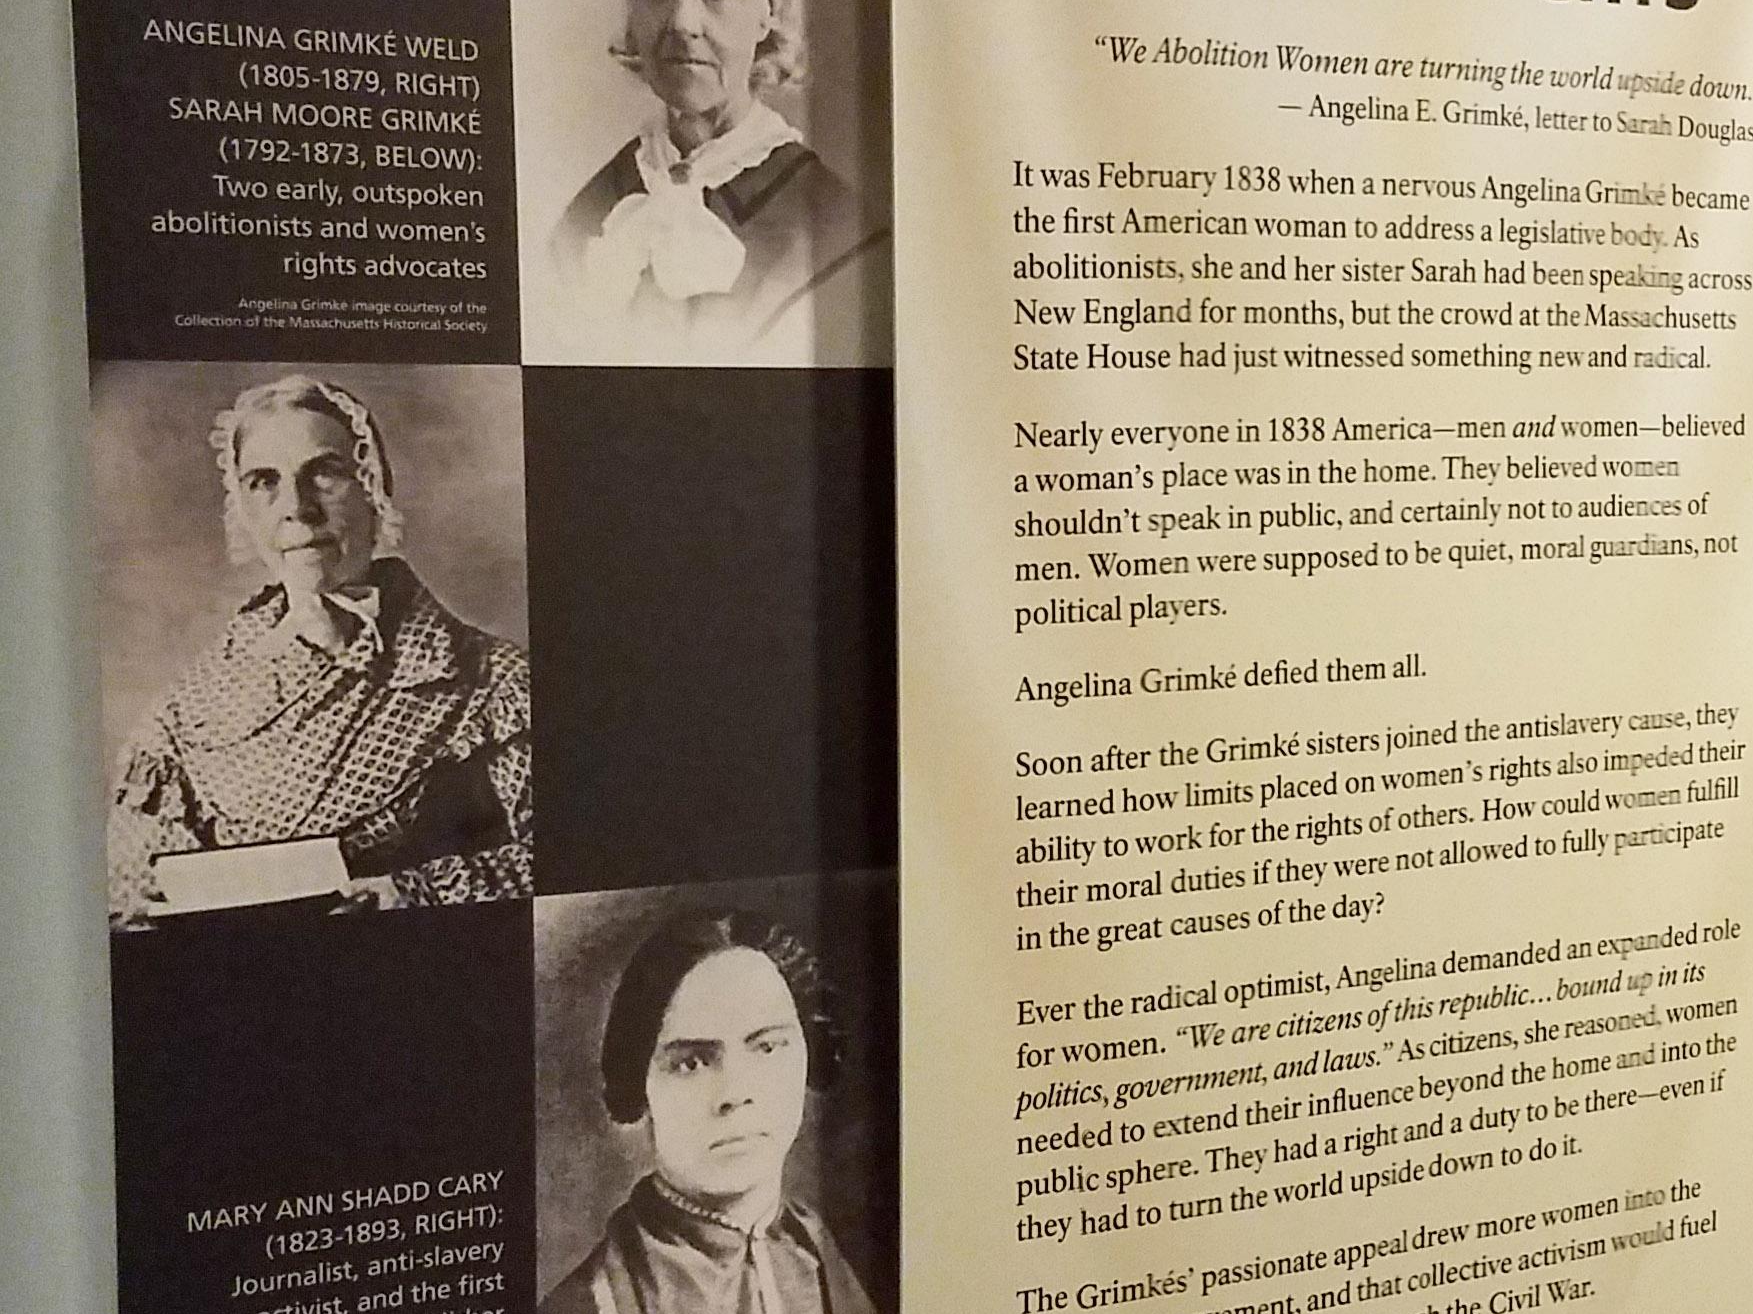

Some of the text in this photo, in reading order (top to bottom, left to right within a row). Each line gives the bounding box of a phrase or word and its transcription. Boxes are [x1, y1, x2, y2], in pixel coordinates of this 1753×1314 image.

[142, 17, 478, 62] ANGELINA GRIMKÉ WELD
[238, 60, 480, 103] (1805-1879, RIGHT)
[168, 95, 482, 135] SARAH MOORE GRIMKÉ
[218, 135, 483, 175] (1792-1873, BELOW):
[211, 172, 483, 210] Two early, outspoken
[150, 208, 486, 243] abolitionists and women's
[282, 250, 487, 280] rights advocates
[173, 312, 242, 327] Collection
[262, 315, 286, 328] the
[287, 315, 380, 330] Massachusetts
[382, 317, 441, 331] Historical
[443, 317, 488, 335] Society
[1014, 652, 1426, 708] Angelina Grimké defied them all.
[186, 1168, 504, 1233] MARY ANN SHADD CARY
[264, 1202, 503, 1260] (1823-1893, RIGHT):
[230, 1241, 505, 1297] Journalist, anti-slavery
[356, 1283, 403, 1312] and
[409, 1279, 451, 1304] the
[457, 1271, 505, 1296] first
